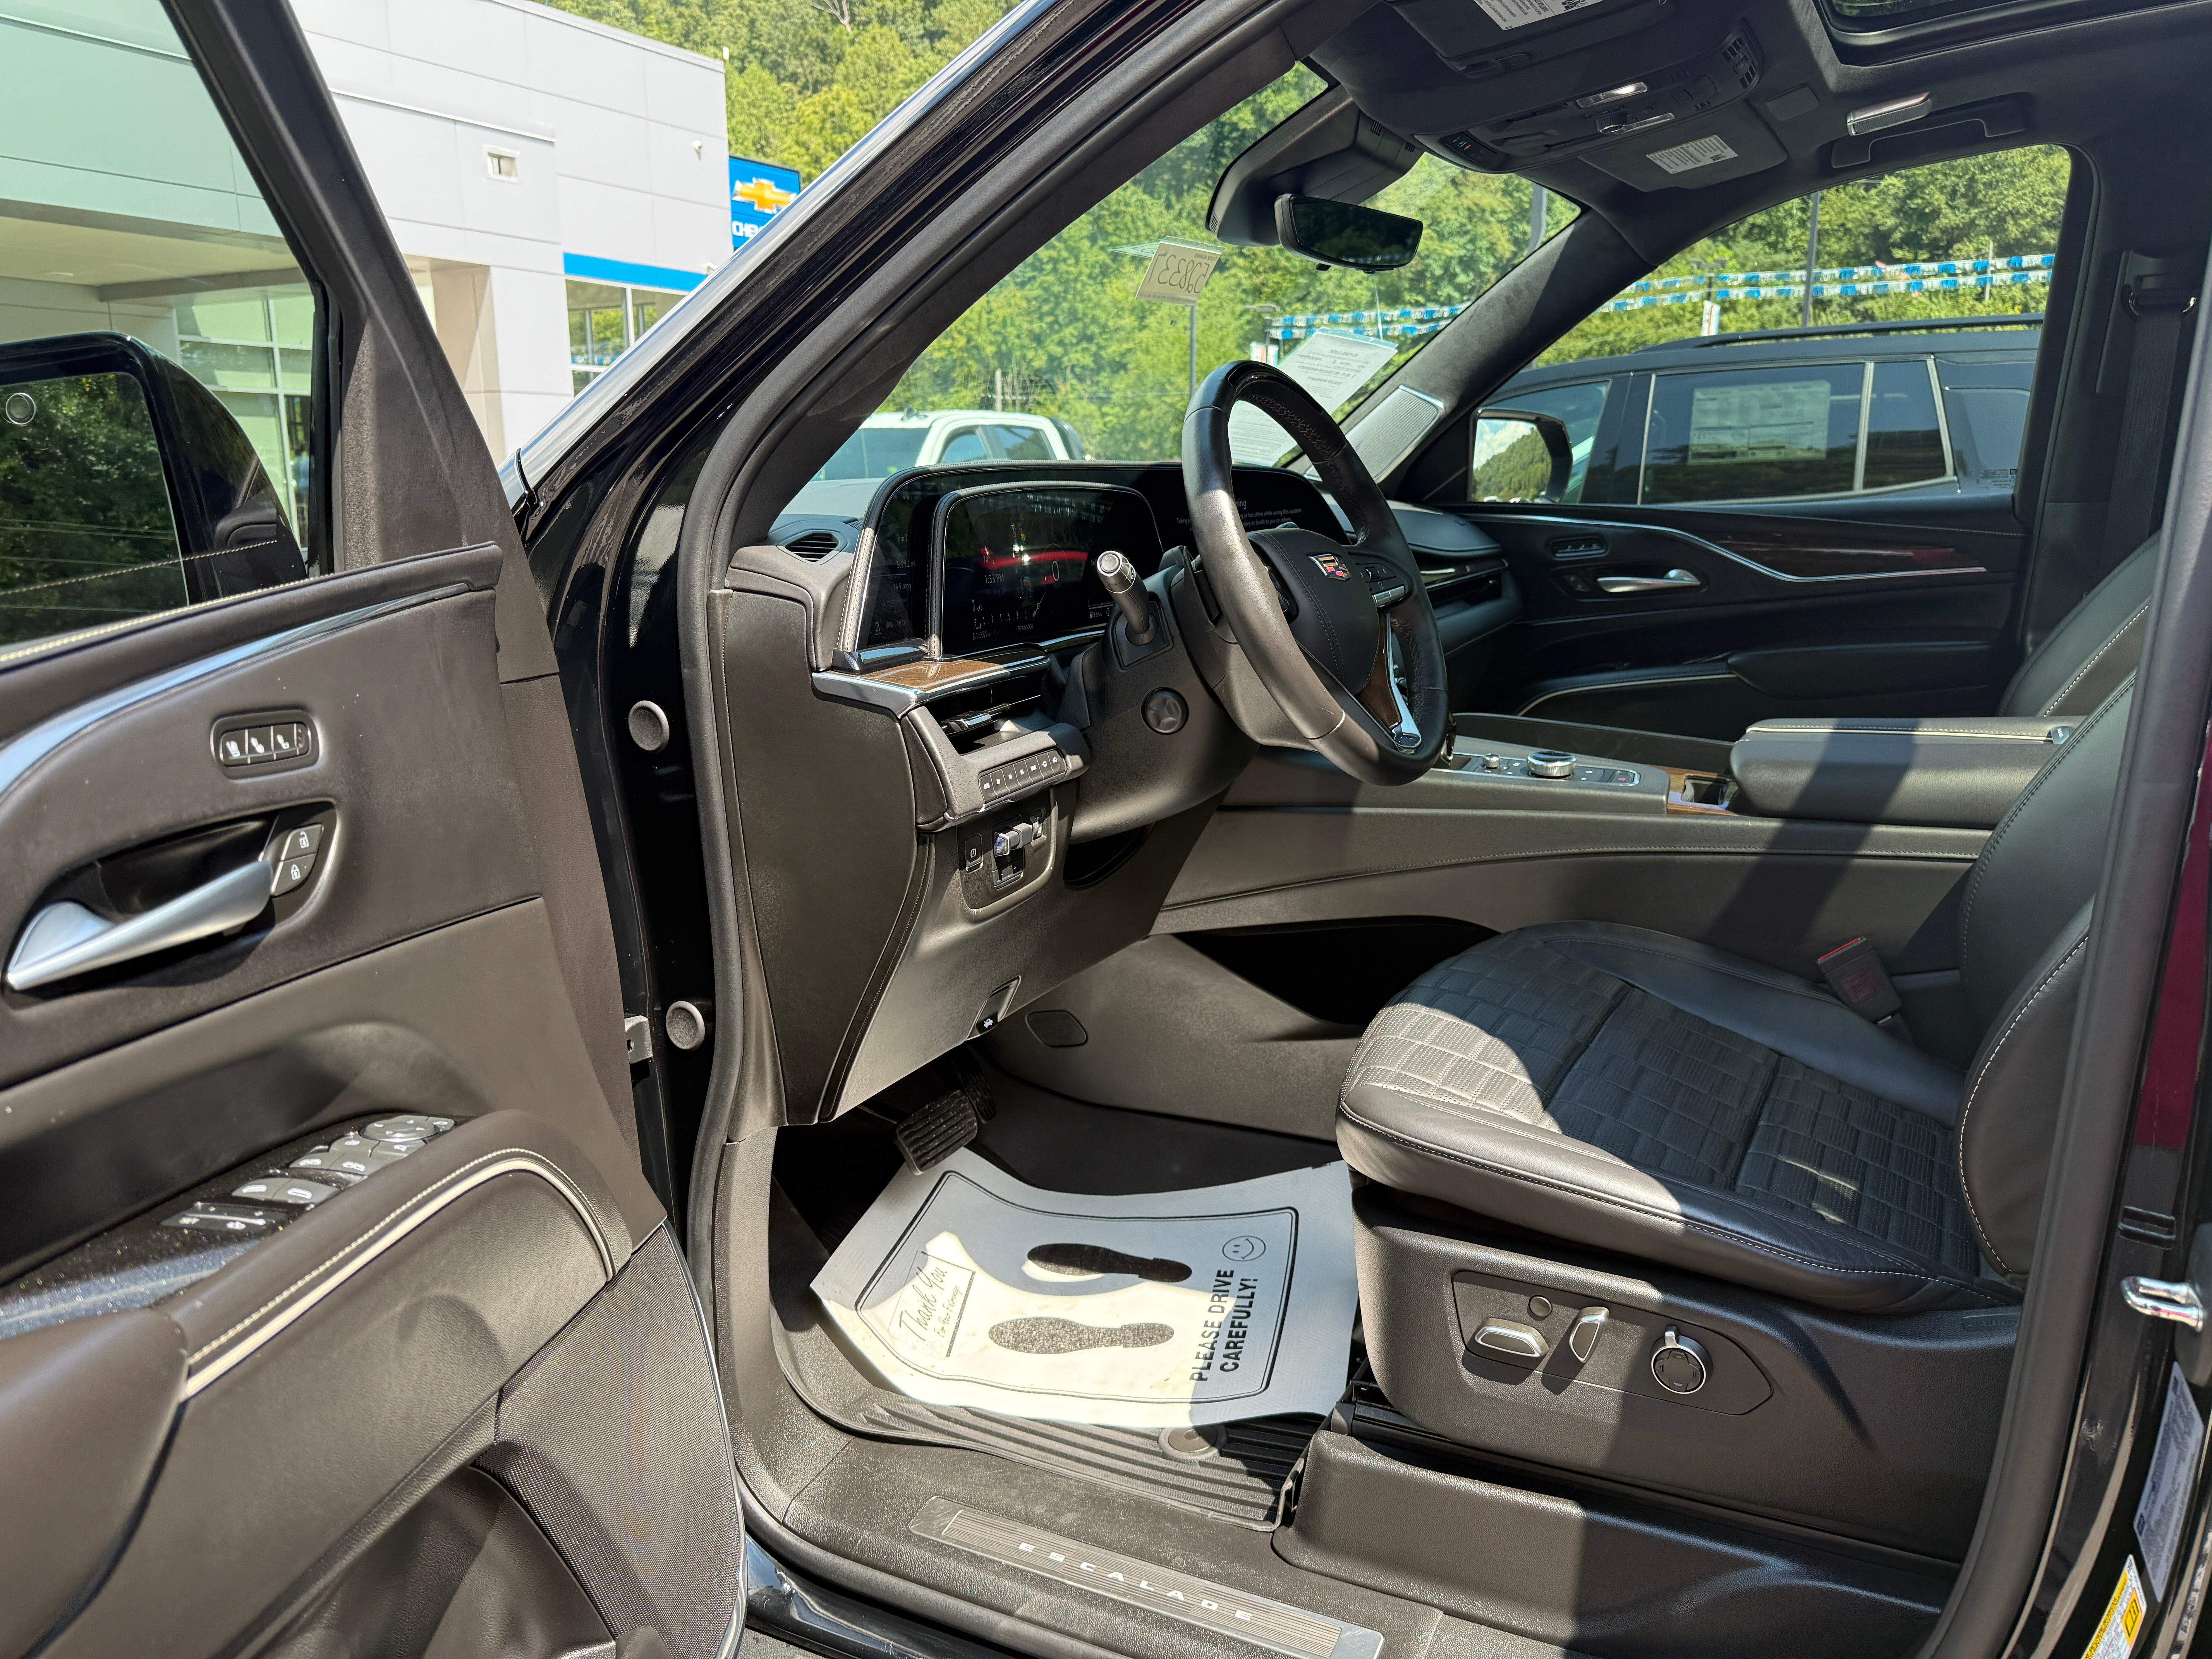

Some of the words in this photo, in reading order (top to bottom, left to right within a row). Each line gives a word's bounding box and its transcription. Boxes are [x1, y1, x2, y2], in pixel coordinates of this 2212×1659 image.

[905, 534, 908, 542] 2
[985, 574, 995, 584] 1:33
[996, 573, 1004, 582] PM
[916, 1266, 947, 1290] You
[899, 1285, 936, 1341] Thank
[934, 1326, 945, 1338] For
[1189, 1320, 1222, 1381] PLEASE
[1207, 1269, 1234, 1314] DRIVE
[1219, 1278, 1258, 1372] CAREFULLY!
[1018, 1542, 1253, 1621] ESCALADE
